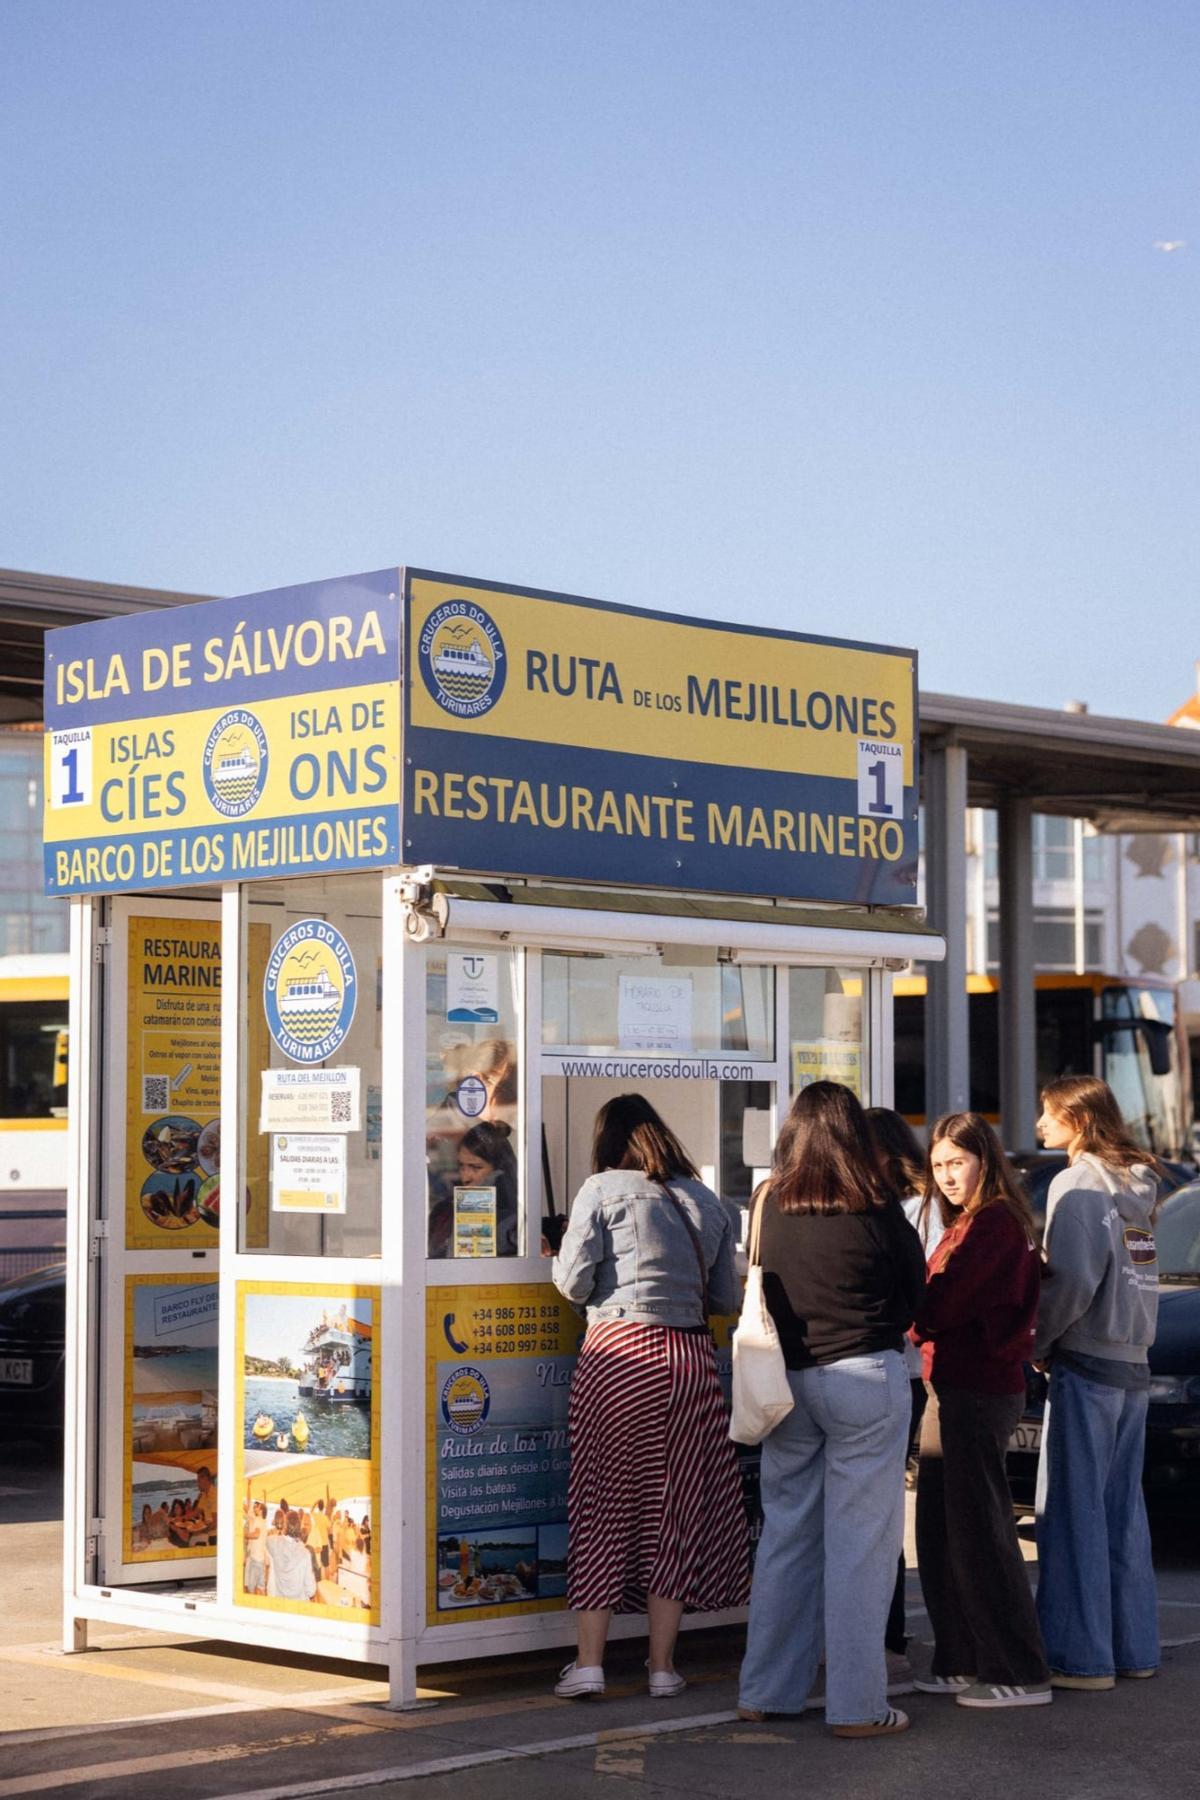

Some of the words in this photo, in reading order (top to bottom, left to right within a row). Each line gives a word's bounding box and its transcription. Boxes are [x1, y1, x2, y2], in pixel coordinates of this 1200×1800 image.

[421, 603, 467, 655] CRUCEROS
[469, 608, 486, 624] DO
[485, 622, 504, 661] ULLA
[57, 654, 130, 705] ISLA
[142, 643, 192, 692] DE
[204, 610, 386, 683] SÁLVORA
[436, 689, 493, 715] TURIMARES
[526, 649, 623, 705] RUTA
[633, 689, 652, 708] DE
[655, 691, 682, 713] LOS
[687, 674, 897, 739] MEJILLONES
[290, 705, 343, 740] ISLA
[351, 699, 385, 732] DE
[53, 731, 91, 746] TAQUILLA
[110, 729, 176, 764] ISLAS
[204, 712, 240, 766] CRUCEROS
[241, 713, 254, 728] DO
[254, 724, 267, 759] ULLA
[860, 742, 901, 756] TAQUILLA
[62, 748, 84, 804] 1
[289, 743, 388, 802] ONS
[100, 763, 187, 823] CÍES
[868, 761, 893, 814] 1
[211, 789, 260, 816] TURIMARES
[414, 768, 695, 842] RESTAURANTE
[708, 802, 904, 861] MARINERO
[57, 844, 135, 886] BARCO
[142, 840, 173, 878] DE
[180, 834, 224, 875] LOS
[232, 816, 388, 870] MEJILLONES
[267, 924, 314, 991] CRUCEROS
[317, 925, 335, 945] DO
[335, 942, 354, 987] ULLA
[156, 998, 185, 1011] Disfruta
[186, 1000, 195, 1011] de
[182, 1016, 194, 1025] con
[276, 1025, 344, 1060] TURIMARES
[277, 1073, 296, 1083] RUTA
[298, 1073, 310, 1082] DEL
[561, 1058, 754, 1081] www.crucerosdoulla.com
[472, 1308, 492, 1320] +34
[495, 1307, 515, 1319] 986
[518, 1306, 537, 1318] 731
[540, 1305, 560, 1317] 818
[472, 1325, 492, 1337] +34
[495, 1324, 515, 1336] 608
[518, 1323, 537, 1335] 089
[540, 1322, 560, 1334] 458
[472, 1342, 492, 1354] +34
[495, 1341, 515, 1353] 620
[518, 1340, 537, 1352] 997
[540, 1339, 560, 1351] 621
[441, 1437, 484, 1458] Ruta
[489, 1434, 508, 1455] de
[514, 1433, 536, 1453] los
[441, 1467, 475, 1481] Salidas
[477, 1463, 508, 1477] diarias
[511, 1461, 539, 1475] desde
[441, 1485, 467, 1499] Visita
[469, 1484, 483, 1497] las
[486, 1482, 517, 1495] bateas
[441, 1501, 499, 1519] Degustación
[502, 1498, 547, 1514] Mejillones
